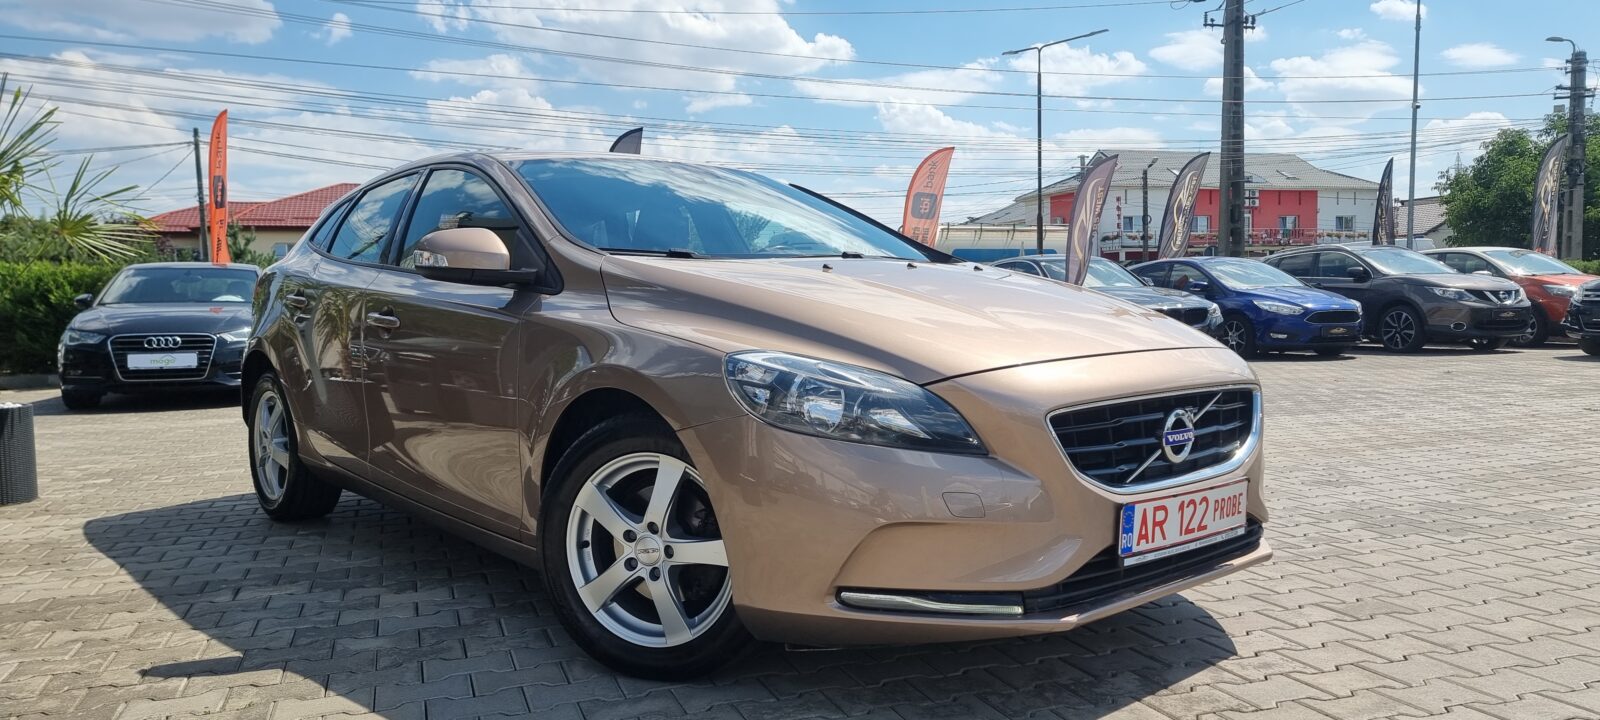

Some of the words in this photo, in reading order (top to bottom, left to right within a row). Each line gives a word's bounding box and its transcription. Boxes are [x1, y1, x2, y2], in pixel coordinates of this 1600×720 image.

[924, 160, 939, 188] bank
[920, 197, 931, 214] tbi
[1094, 185, 1105, 214] WEST
[1167, 431, 1194, 442] VOLVO
[1136, 504, 1169, 547] AR
[1178, 495, 1210, 537] 122
[1212, 492, 1243, 522] PROBE
[1121, 532, 1132, 549] RO
